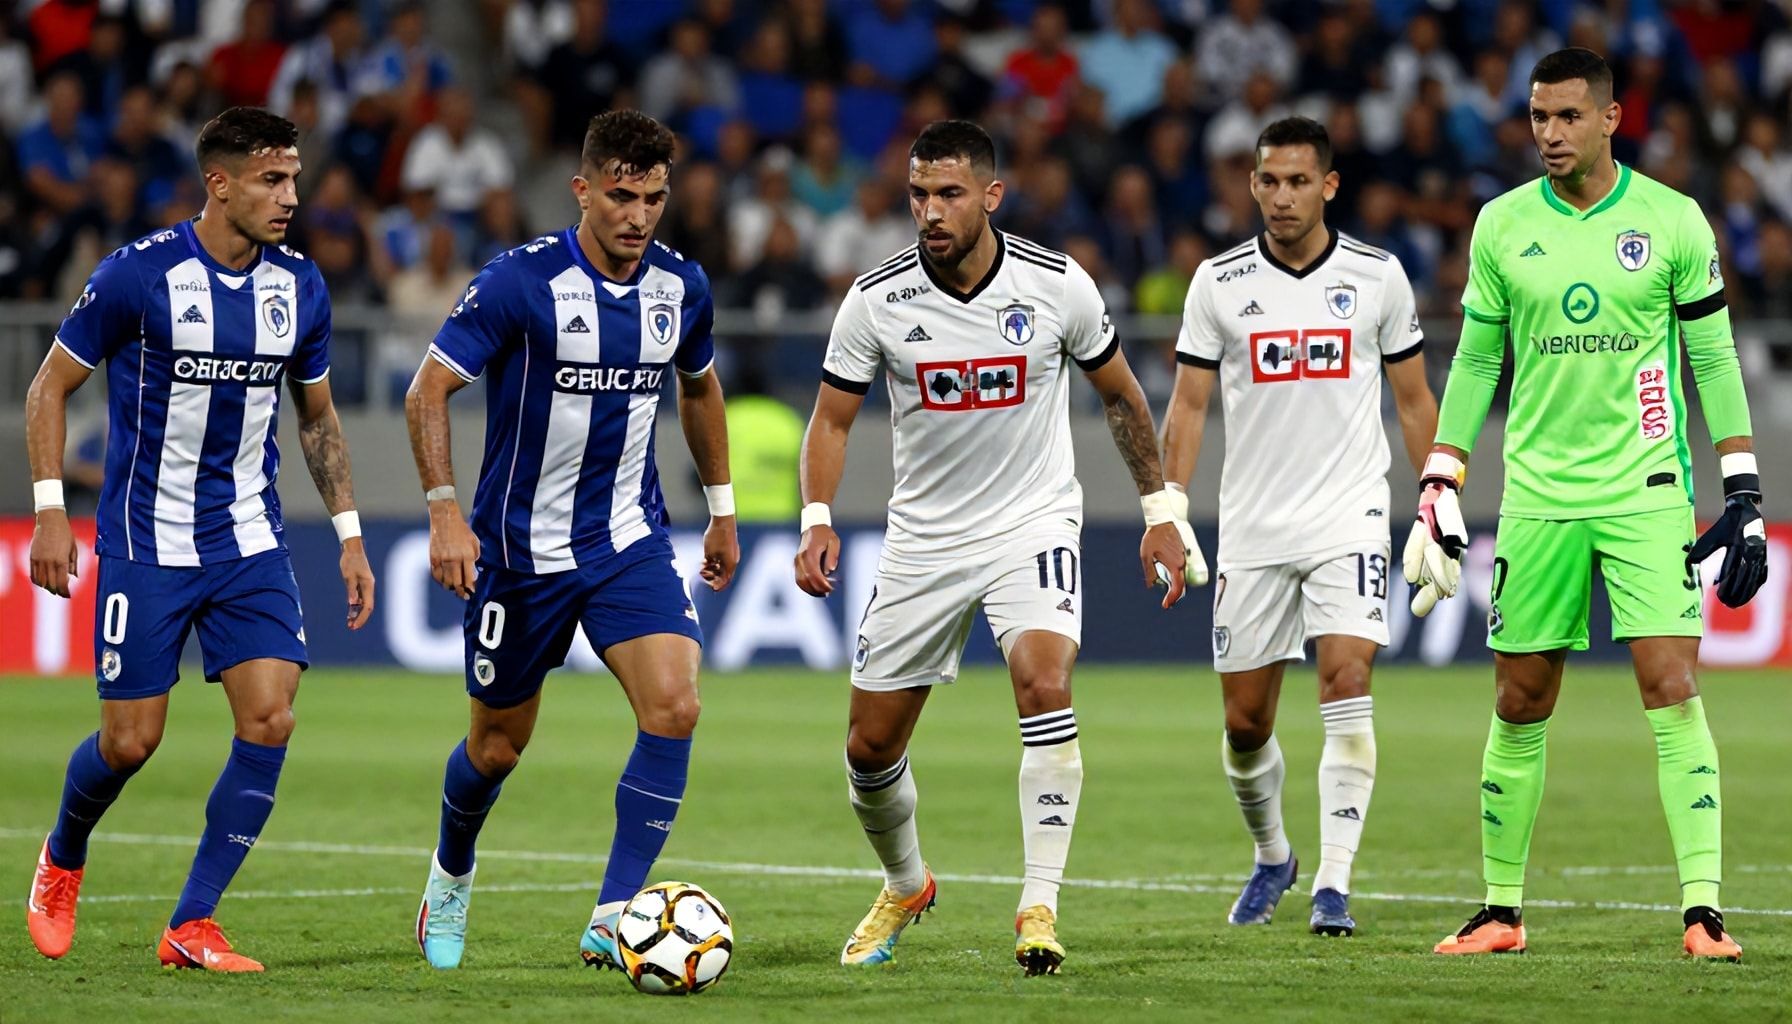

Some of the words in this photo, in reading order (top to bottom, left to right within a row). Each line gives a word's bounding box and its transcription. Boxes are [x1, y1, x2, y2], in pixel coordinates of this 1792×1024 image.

[1037, 547, 1077, 595] 10
[103, 592, 129, 645] 0
[479, 601, 506, 650] 0
